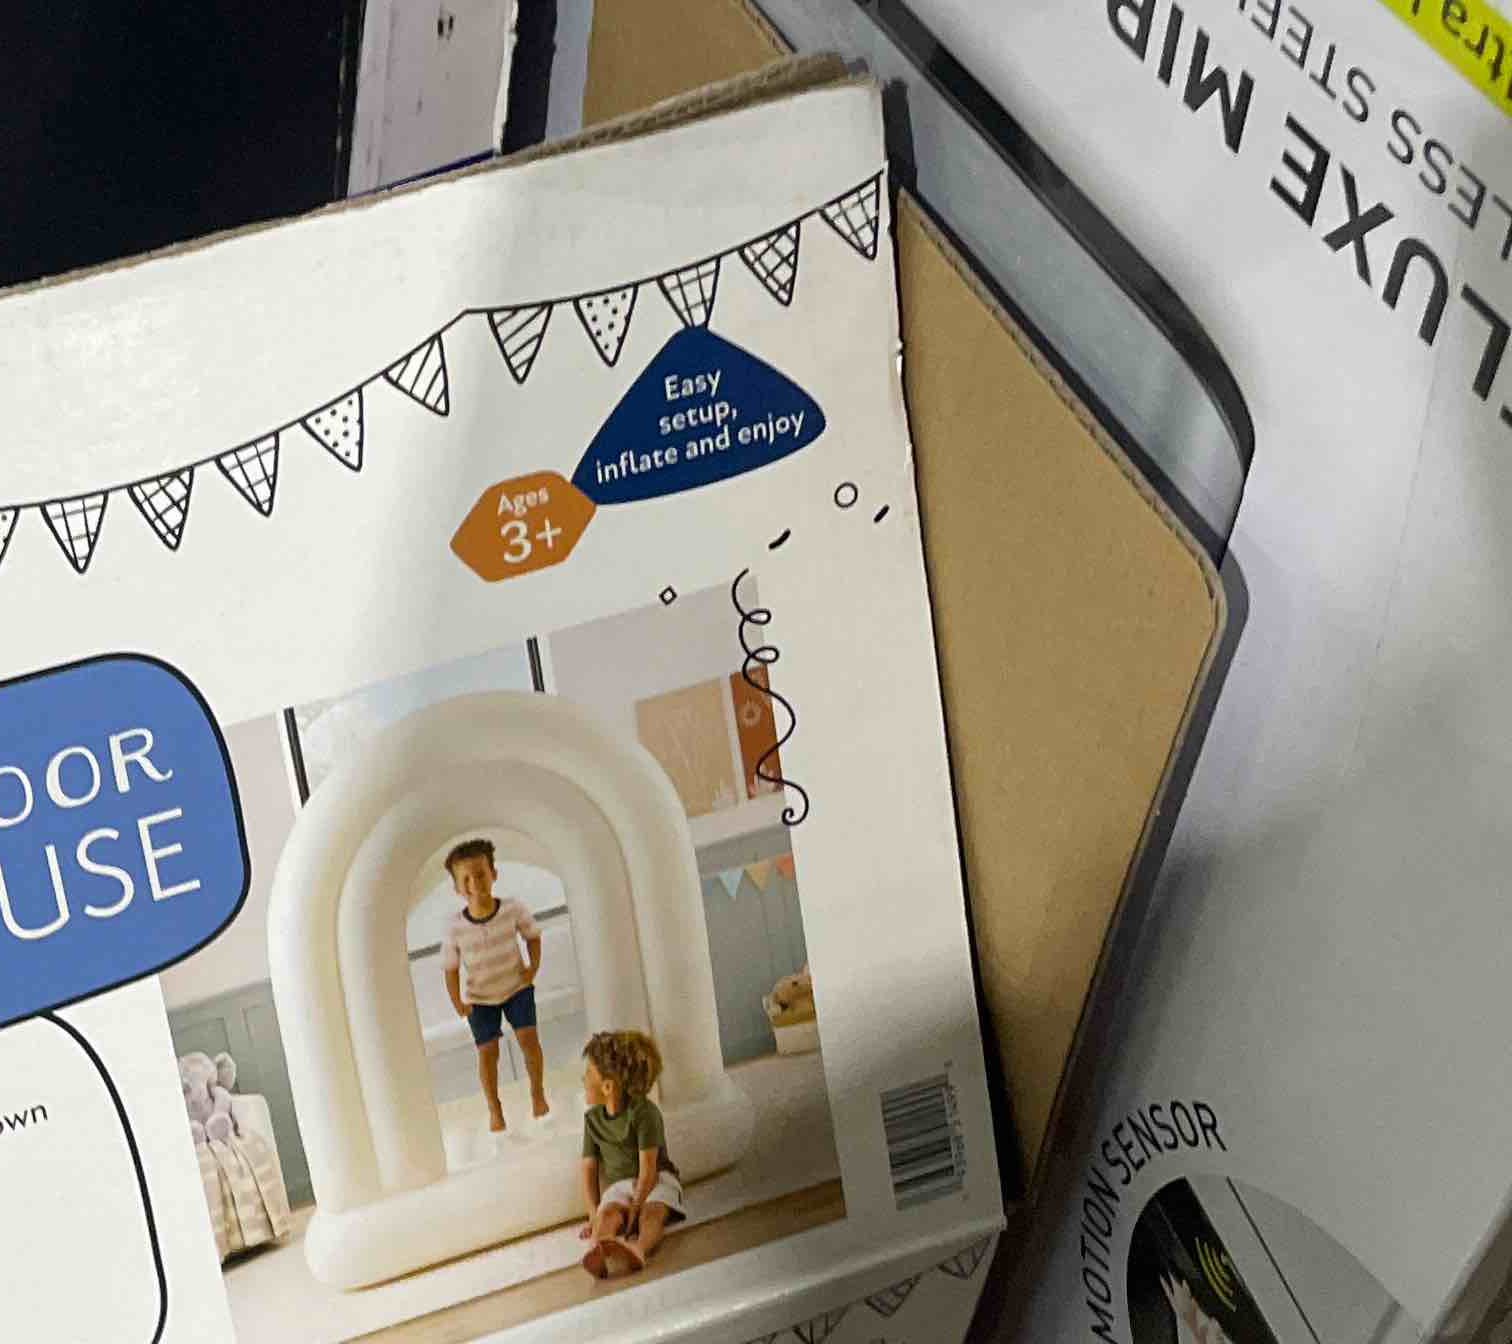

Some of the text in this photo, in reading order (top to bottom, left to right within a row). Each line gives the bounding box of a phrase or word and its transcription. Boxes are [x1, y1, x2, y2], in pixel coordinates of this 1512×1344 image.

[1268, 109, 1512, 429] LUXE
[664, 368, 723, 404] Easy
[658, 398, 740, 437] setup,
[594, 409, 807, 487] inflate and enjoy
[496, 484, 551, 518] Ages
[499, 516, 564, 566] 3+
[1097, 1098, 1228, 1188] SENSOR
